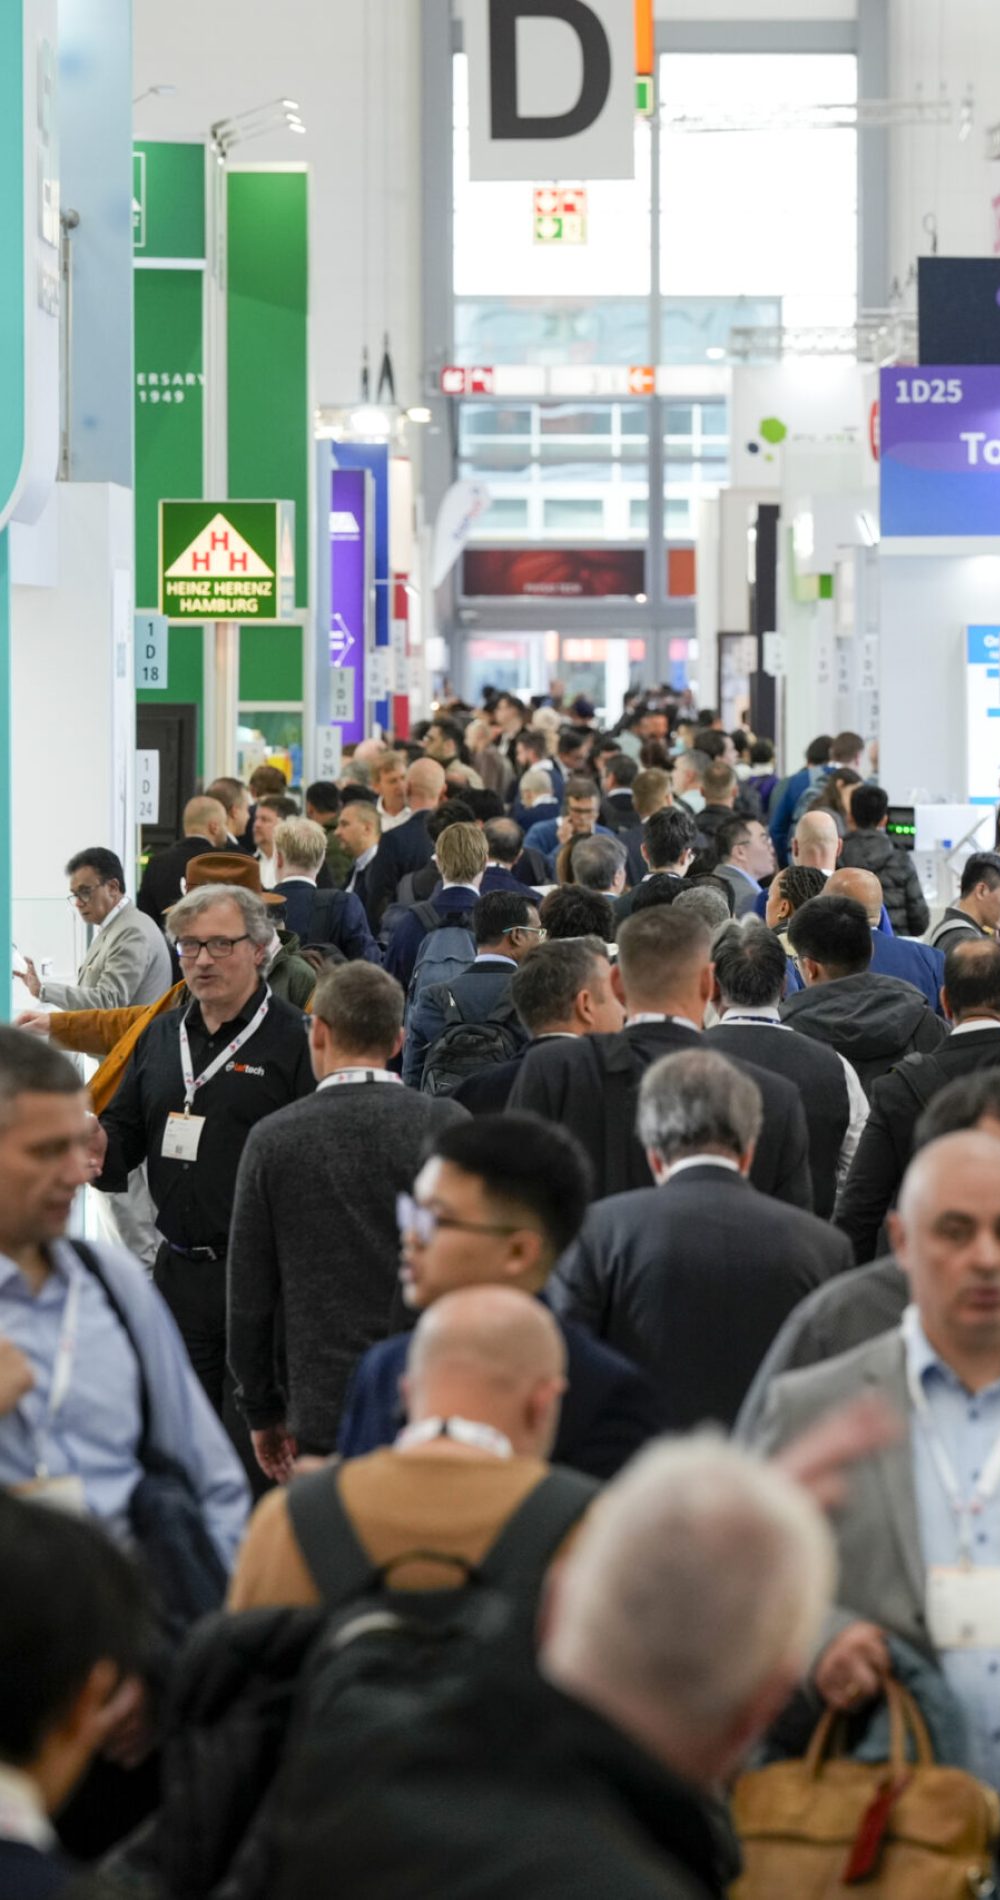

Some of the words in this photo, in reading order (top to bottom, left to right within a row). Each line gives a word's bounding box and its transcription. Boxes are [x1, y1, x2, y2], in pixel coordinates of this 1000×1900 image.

[488, 0, 611, 140] D
[139, 390, 184, 403] 1949
[896, 379, 963, 404] 1D25
[211, 531, 228, 551] H
[192, 551, 210, 571] H
[230, 551, 247, 571] H
[166, 581, 211, 596] HEINZ
[214, 581, 272, 596] HERENZ
[180, 597, 258, 613] HAMBURG
[148, 622, 154, 637] 1
[146, 645, 156, 660] D
[142, 667, 159, 682] 18
[144, 758, 150, 771] 1
[142, 779, 151, 794] D
